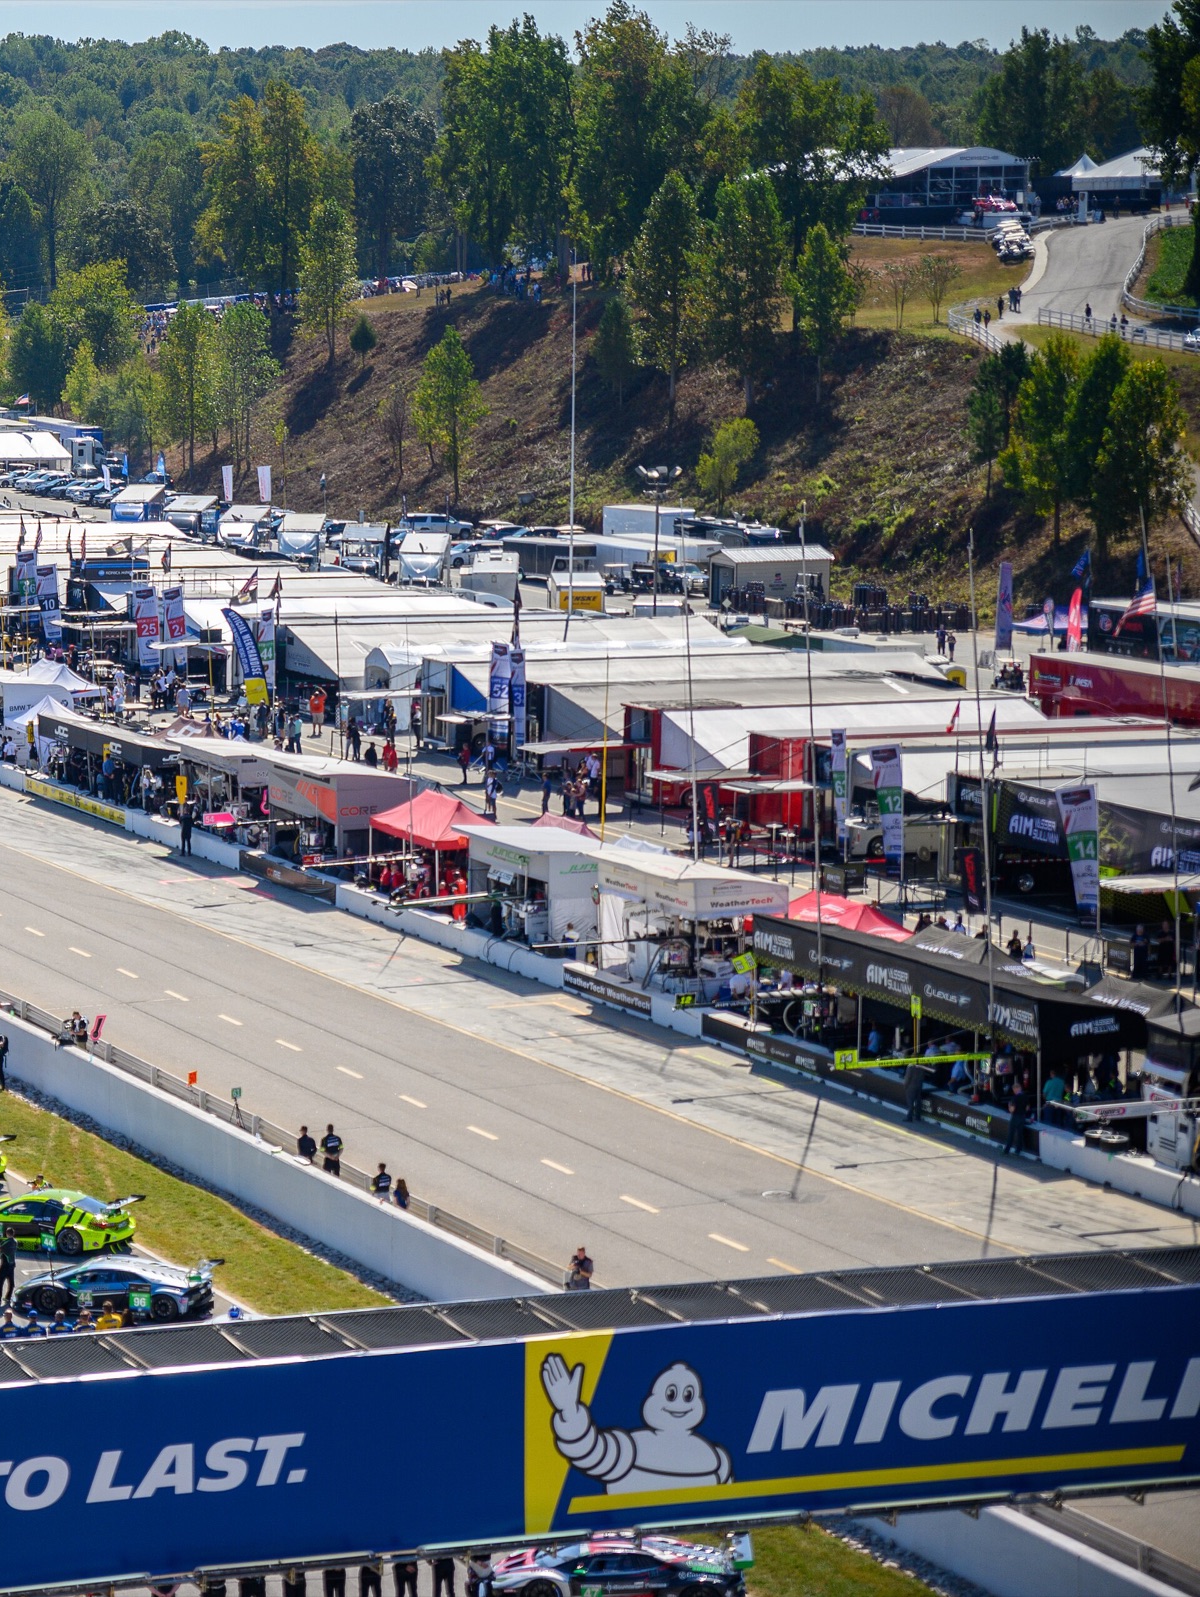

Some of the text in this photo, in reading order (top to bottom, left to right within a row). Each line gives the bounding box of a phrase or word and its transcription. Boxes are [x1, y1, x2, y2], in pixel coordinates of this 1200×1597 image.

[42, 599, 55, 610] 10
[142, 624, 156, 636] 25
[228, 612, 262, 676] OFFICIAL MERCHANDISE
[260, 648, 272, 659] 44
[492, 684, 508, 698] 52
[270, 786, 294, 804] CORE
[1025, 796, 1046, 805] LEXUS
[340, 806, 378, 816] CORE
[884, 796, 901, 812] 12
[1009, 814, 1034, 838] AIM
[1032, 830, 1059, 845] SULLIVAN
[1074, 840, 1095, 858] 14
[604, 878, 638, 892] WeatherTech
[654, 891, 688, 907] WeatherTech
[710, 897, 774, 908] WeatherTech
[754, 930, 772, 952] AIM
[820, 956, 841, 968] EXUS
[866, 964, 888, 988] AIM
[564, 973, 650, 1010] WeatherTech WeatherTech
[888, 979, 912, 996] SULLIVAN
[680, 996, 691, 1004] 12
[932, 990, 958, 1004] LEXUS
[1009, 1020, 1038, 1037] SULLIVAN
[1070, 1022, 1094, 1038] AIM
[78, 1292, 91, 1302] 44
[134, 1297, 146, 1307] 96
[86, 1432, 308, 1504] LAST.
[584, 1586, 600, 1597] 47
